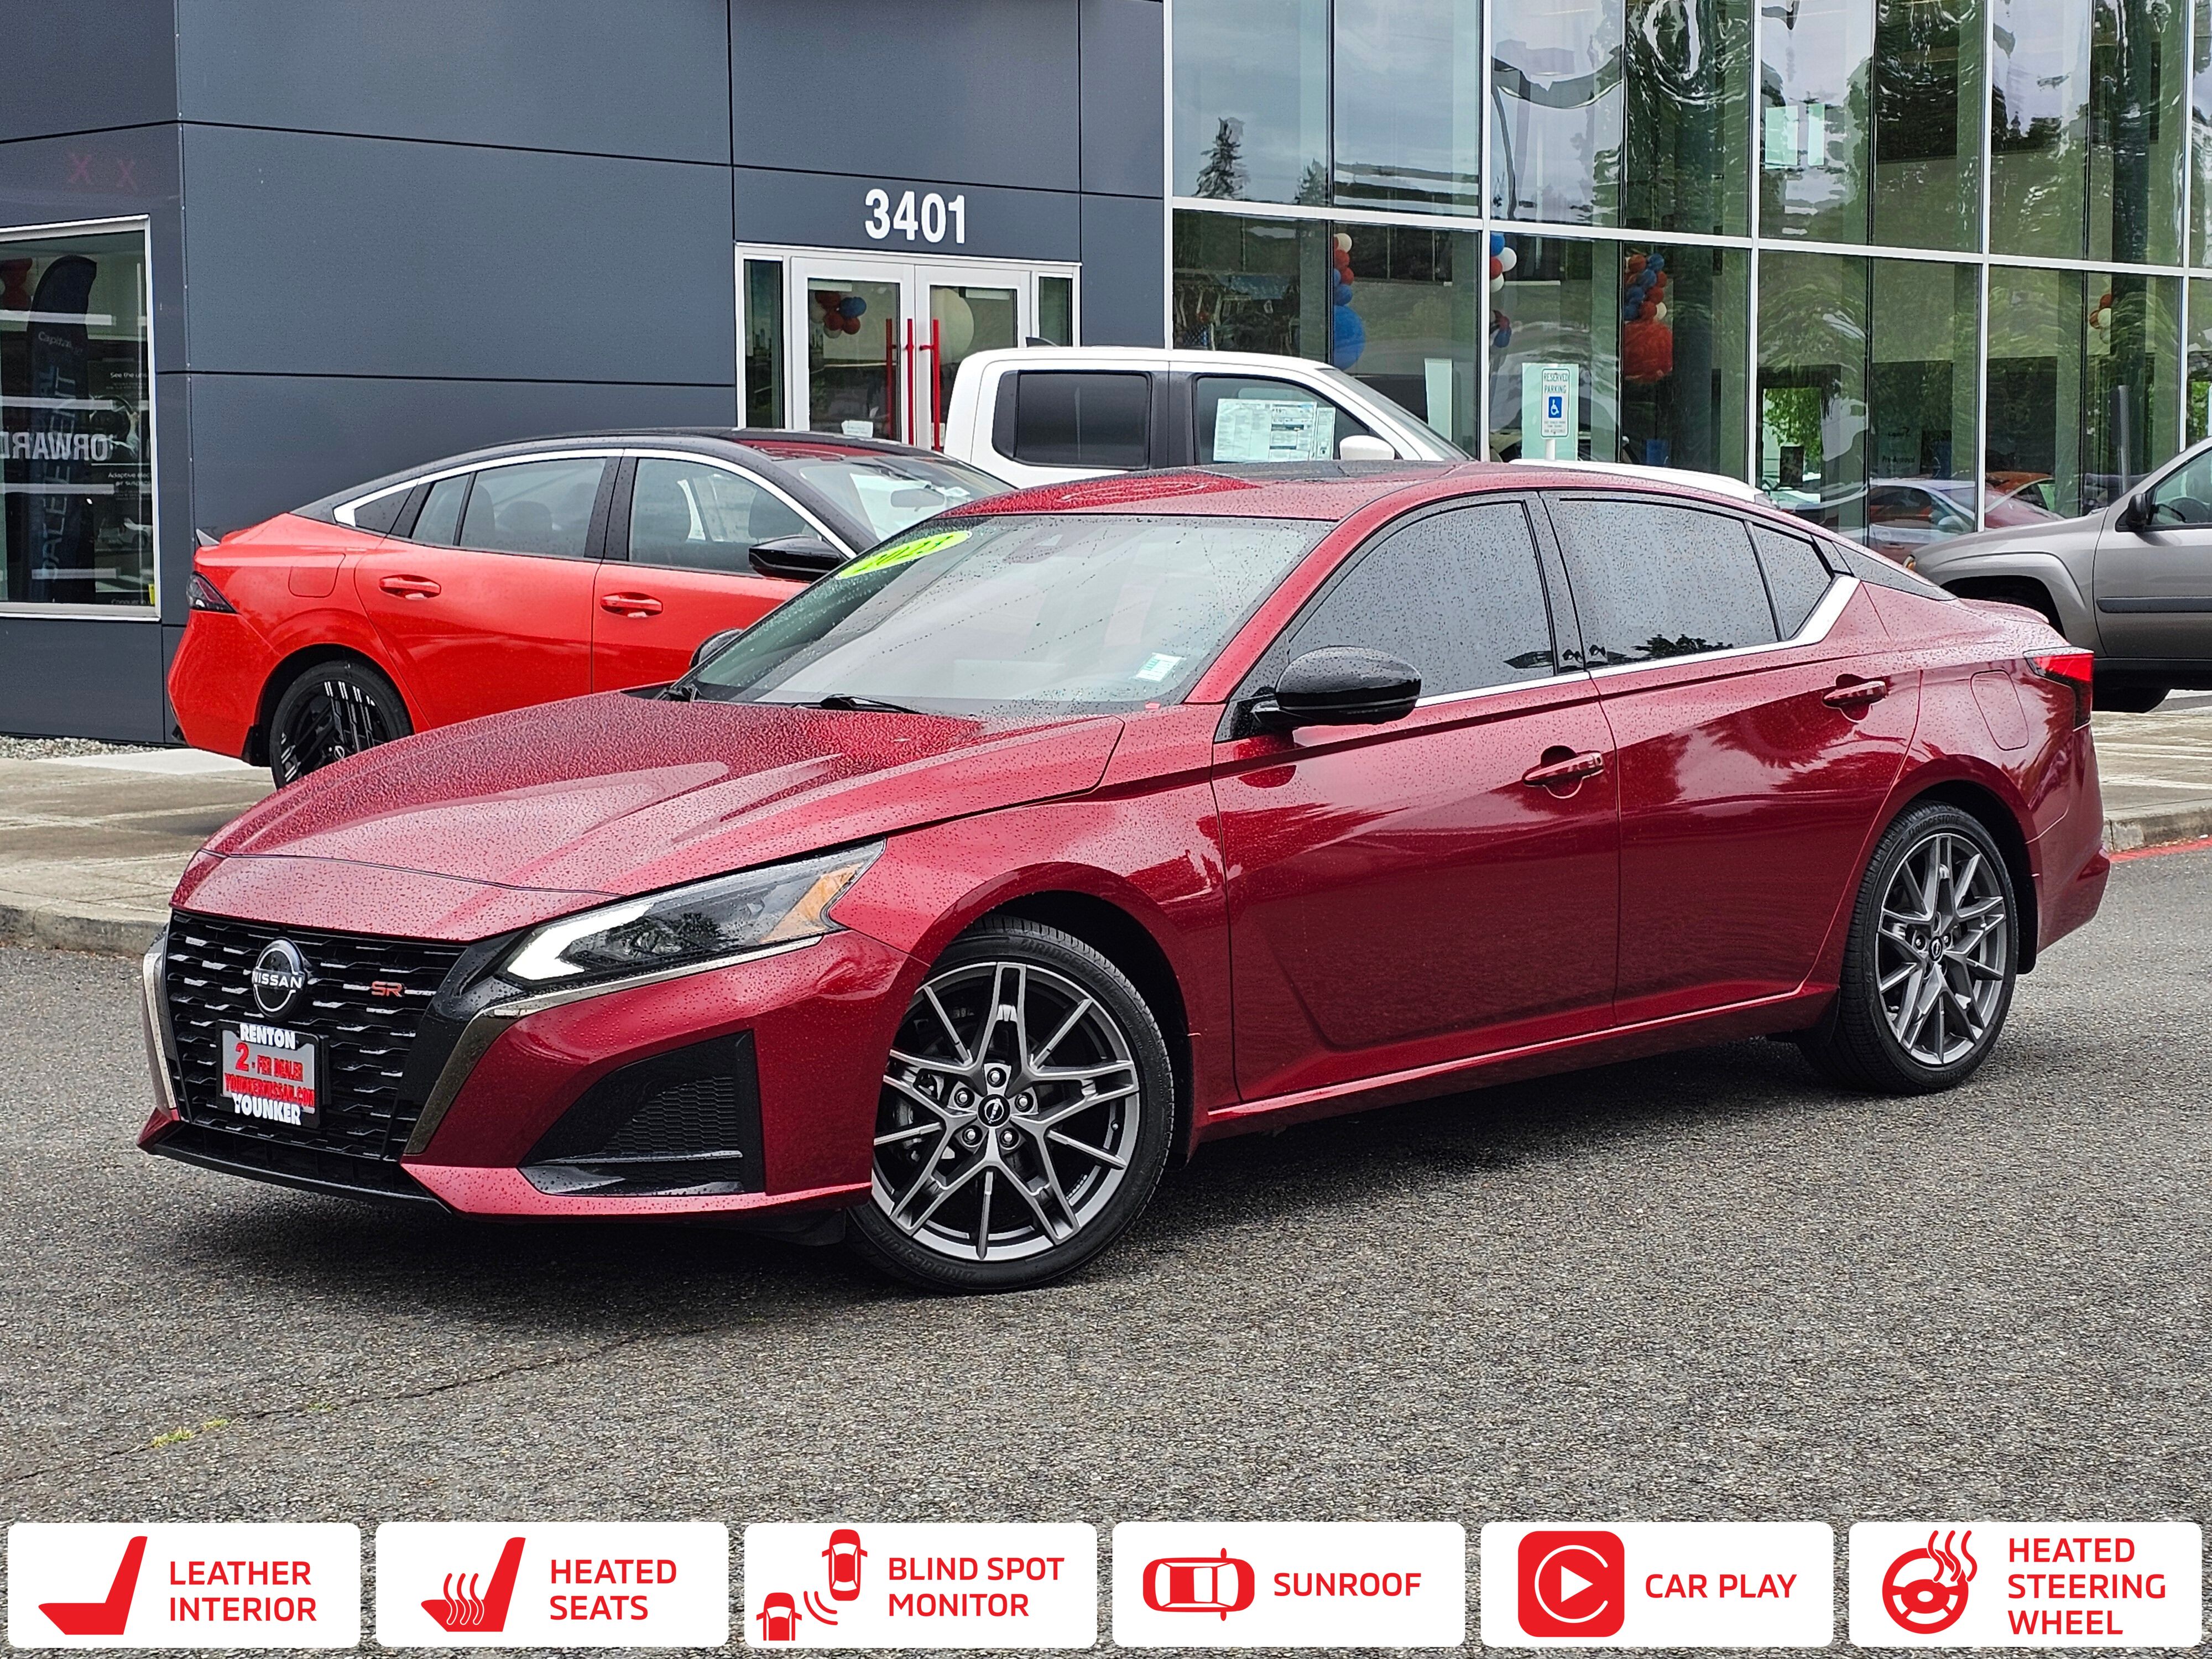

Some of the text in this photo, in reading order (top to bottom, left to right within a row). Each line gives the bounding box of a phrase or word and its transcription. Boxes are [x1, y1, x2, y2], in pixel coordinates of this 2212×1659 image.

[865, 189, 965, 244] 3401
[1543, 372, 1569, 382] RESERVED
[1544, 384, 1567, 394] PARKING
[1908, 814, 1961, 839] BRIDGESTONE
[252, 970, 303, 989] NISSAN
[1019, 937, 1118, 1000] BRIDGESTONE
[371, 980, 404, 997] SR
[239, 1023, 296, 1050] RENTON
[274, 1057, 304, 1082] DEALER
[224, 1072, 315, 1108] YOUNKERNISSAN.COM
[231, 1092, 301, 1126] YOUNKER
